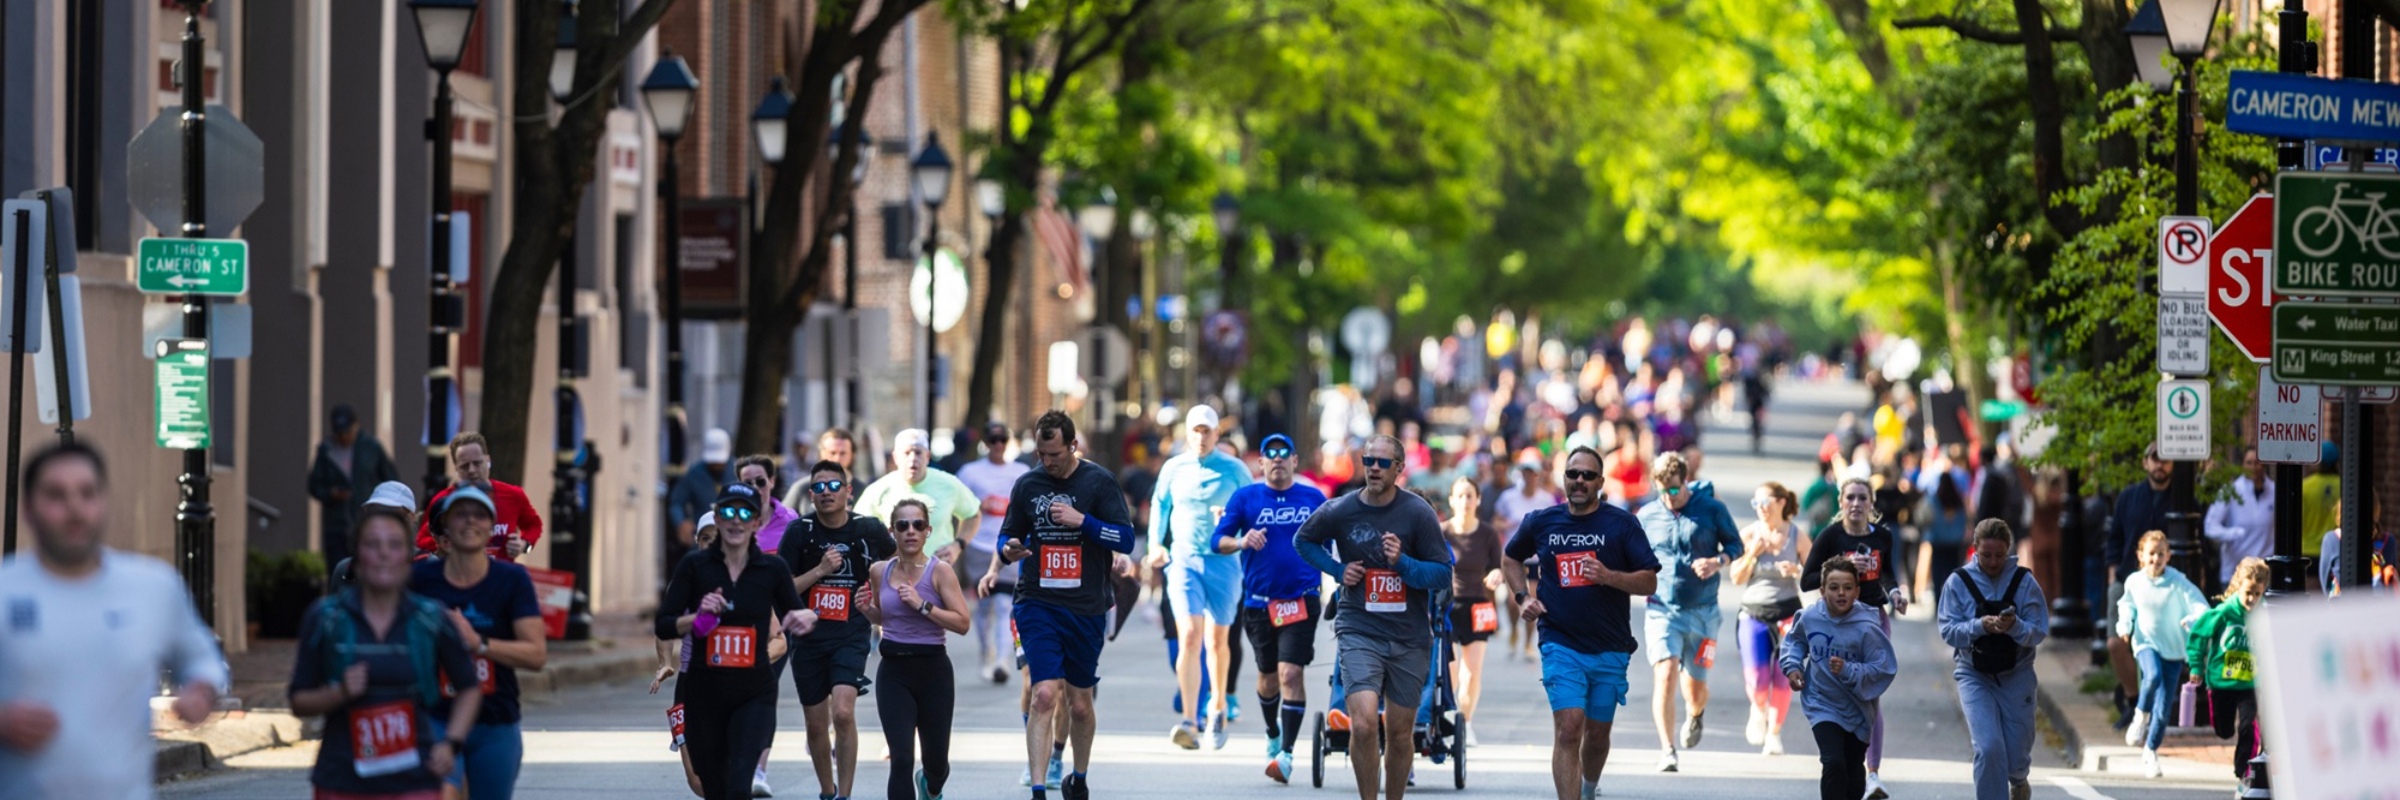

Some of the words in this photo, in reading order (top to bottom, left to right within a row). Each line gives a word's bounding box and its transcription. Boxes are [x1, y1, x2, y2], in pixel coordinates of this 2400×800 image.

[2232, 87, 2340, 122] CAMERON
[2352, 98, 2400, 128] MEW
[174, 244, 206, 257] THRU
[212, 245, 220, 257] 5
[146, 257, 211, 273] CAMERON
[221, 259, 238, 275] ST
[2287, 261, 2339, 286] BIKE
[2351, 263, 2400, 288] ROU
[2162, 302, 2178, 315] NO
[2184, 302, 2206, 315] BUS
[2164, 317, 2204, 327] LOADING
[2334, 316, 2371, 331] Water
[2374, 317, 2398, 331] Taxi
[2161, 328, 2206, 338] UNLOADING
[2177, 339, 2190, 349] OR
[2167, 350, 2198, 361] IDLING
[2310, 349, 2338, 367] King
[2340, 350, 2375, 364] Street
[2278, 385, 2300, 403] NO
[2260, 422, 2317, 442] PARKING
[1549, 533, 1605, 546] RIVERON
[1046, 552, 1077, 569] 1615
[1371, 576, 1402, 592] 1788
[815, 592, 845, 610] 1489
[1275, 601, 1298, 617] 209
[714, 634, 750, 655] 1111
